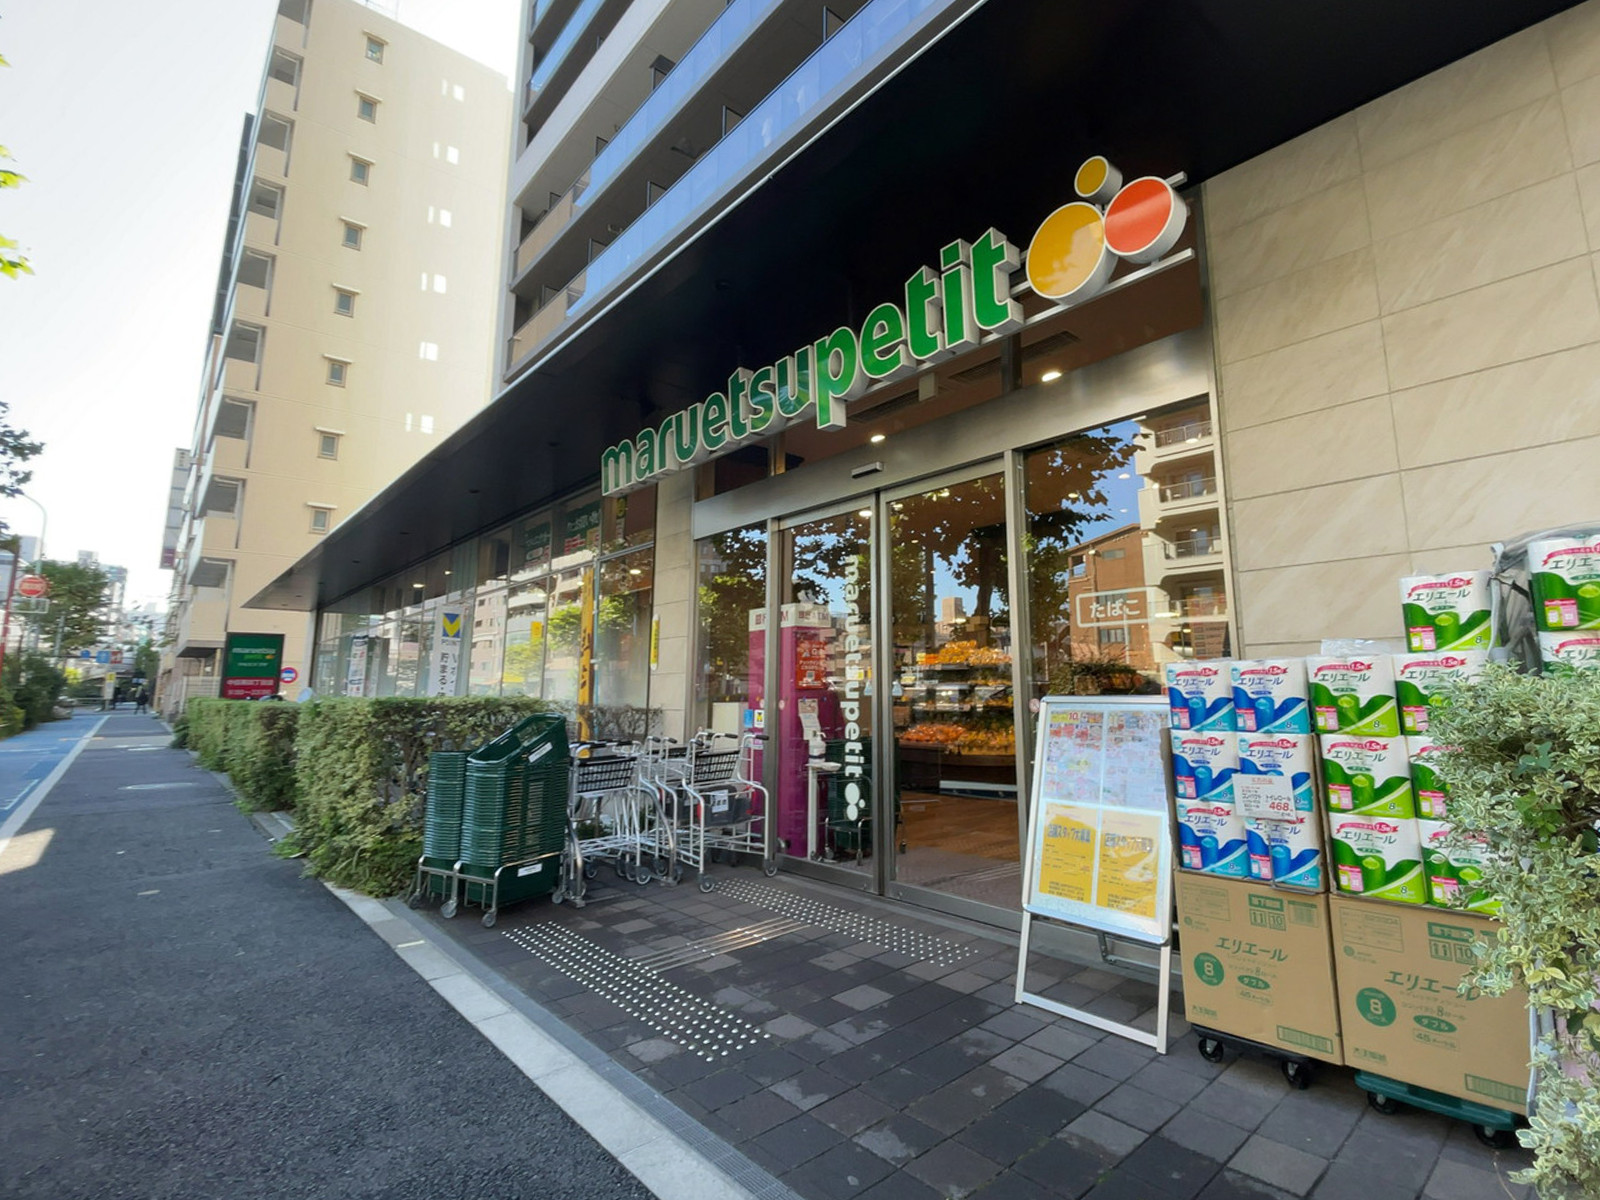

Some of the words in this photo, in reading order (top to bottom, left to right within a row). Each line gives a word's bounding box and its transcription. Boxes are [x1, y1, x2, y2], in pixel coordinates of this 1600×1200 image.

[601, 227, 1021, 495] maruetsupetit
[1413, 590, 1471, 602] エリエール
[1090, 598, 1141, 618] たばこ
[1174, 678, 1215, 687] エリエール
[1239, 676, 1283, 687] エリエール
[1320, 672, 1370, 683] エリエール
[1180, 746, 1221, 756] エリエール
[1249, 749, 1293, 759] エリエール
[1332, 751, 1386, 762] エリエール
[1388, 802, 1396, 810] 8
[1184, 815, 1227, 826] エリエール
[1254, 822, 1301, 835] エエール
[1341, 831, 1397, 844] エリエール
[1401, 886, 1408, 894] 8
[1215, 937, 1289, 962] エリエール
[1203, 961, 1214, 976] 8
[1370, 999, 1382, 1015] 8
